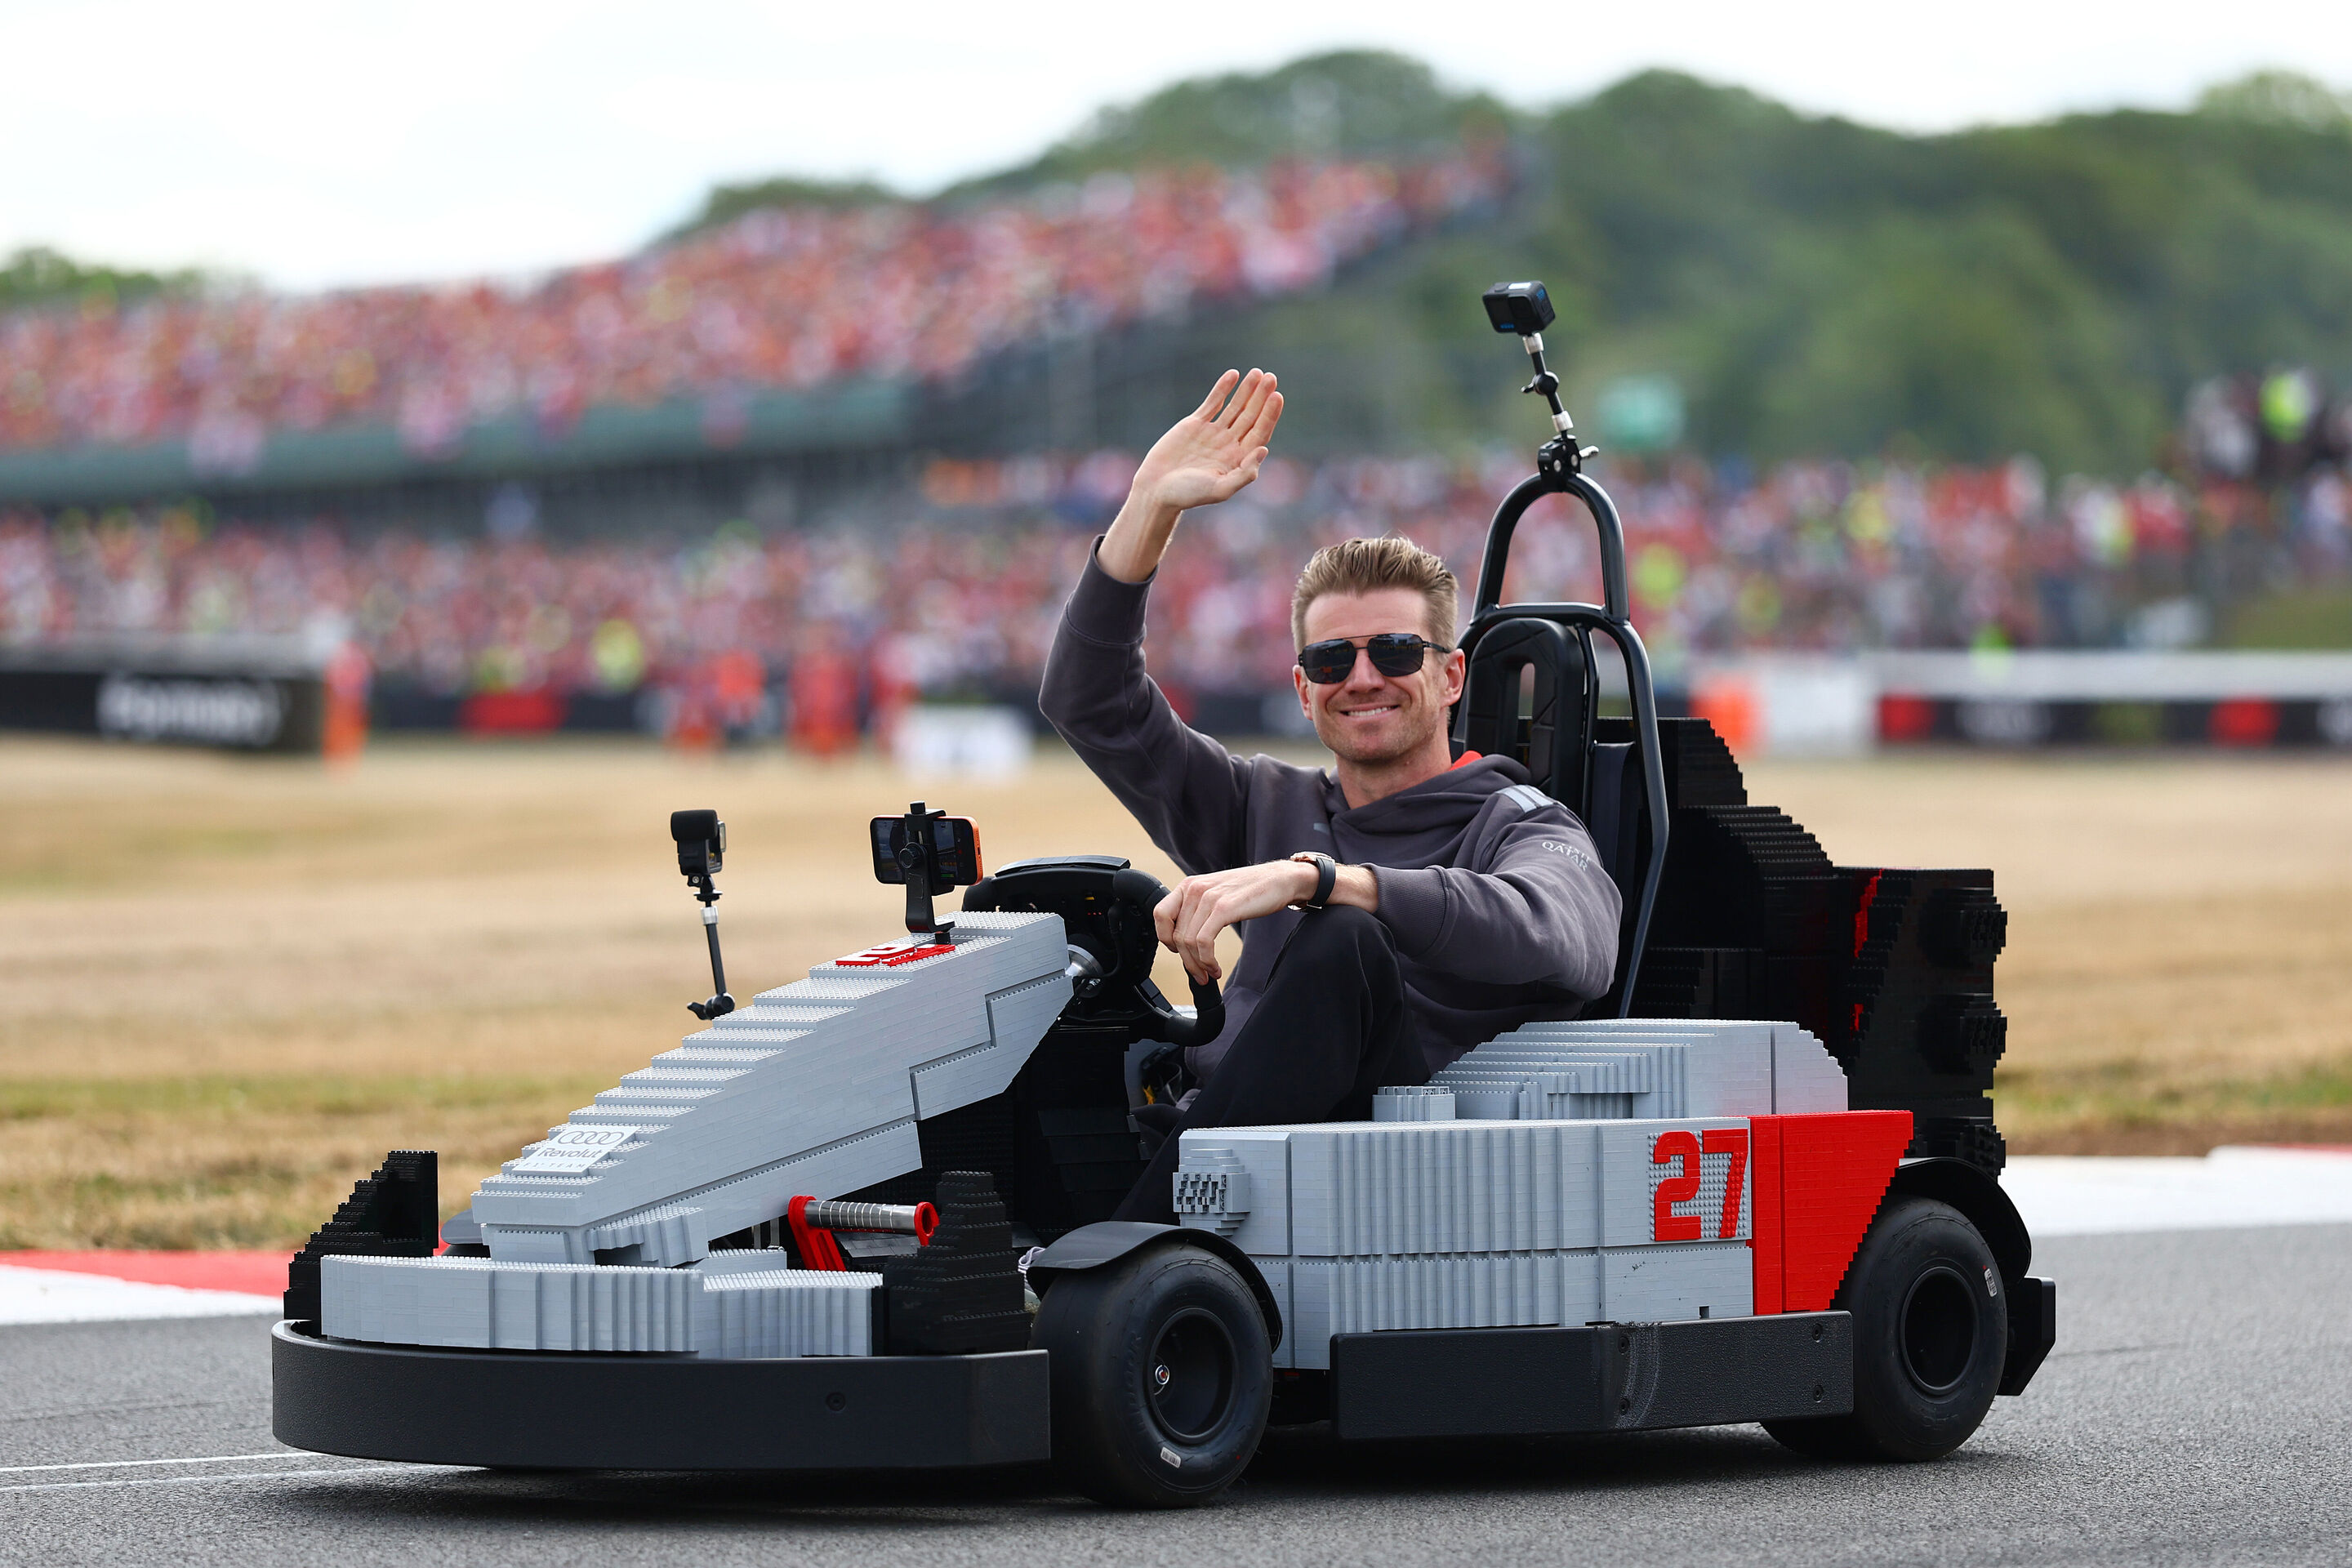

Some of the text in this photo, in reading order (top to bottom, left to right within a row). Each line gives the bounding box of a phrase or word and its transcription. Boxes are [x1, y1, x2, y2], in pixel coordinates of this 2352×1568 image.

[1541, 841, 1588, 871] QATAR
[537, 1147, 603, 1158] Revolut
[1653, 1128, 1749, 1242] 27
